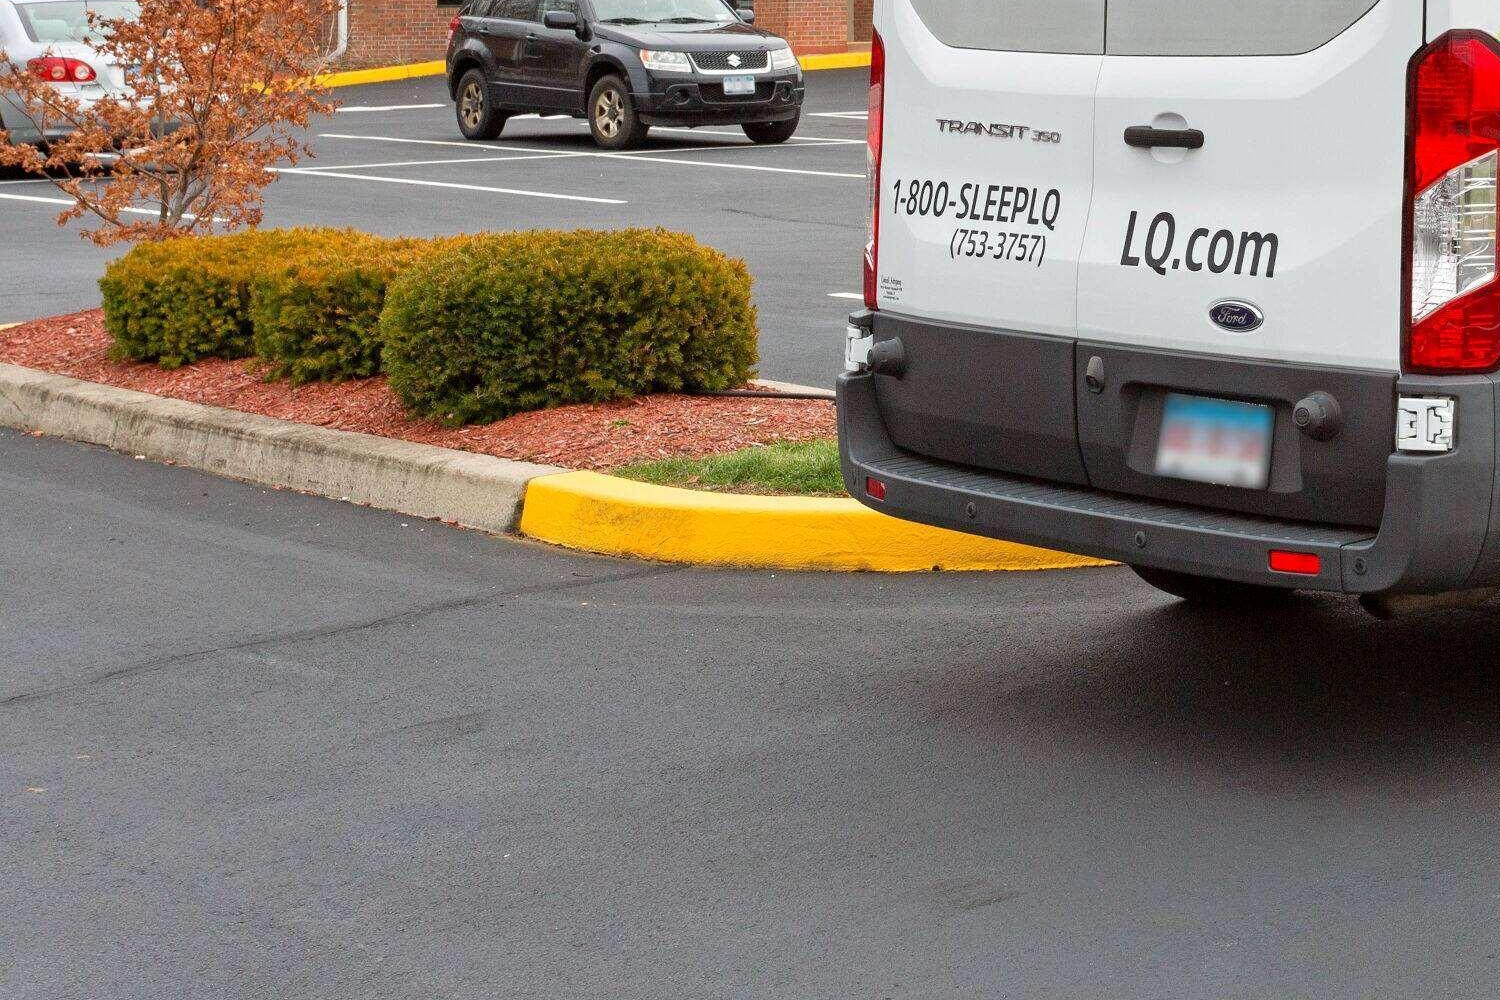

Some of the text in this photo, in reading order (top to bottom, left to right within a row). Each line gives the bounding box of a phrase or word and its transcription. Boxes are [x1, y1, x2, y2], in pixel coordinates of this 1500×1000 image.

[936, 119, 1061, 143] TRANSIT 350
[893, 179, 1061, 230] 1-800-SLEEPLQ
[950, 229, 1046, 267] (753-3757)
[1120, 211, 1278, 278] LQ.com
[1218, 306, 1248, 325] Ford
